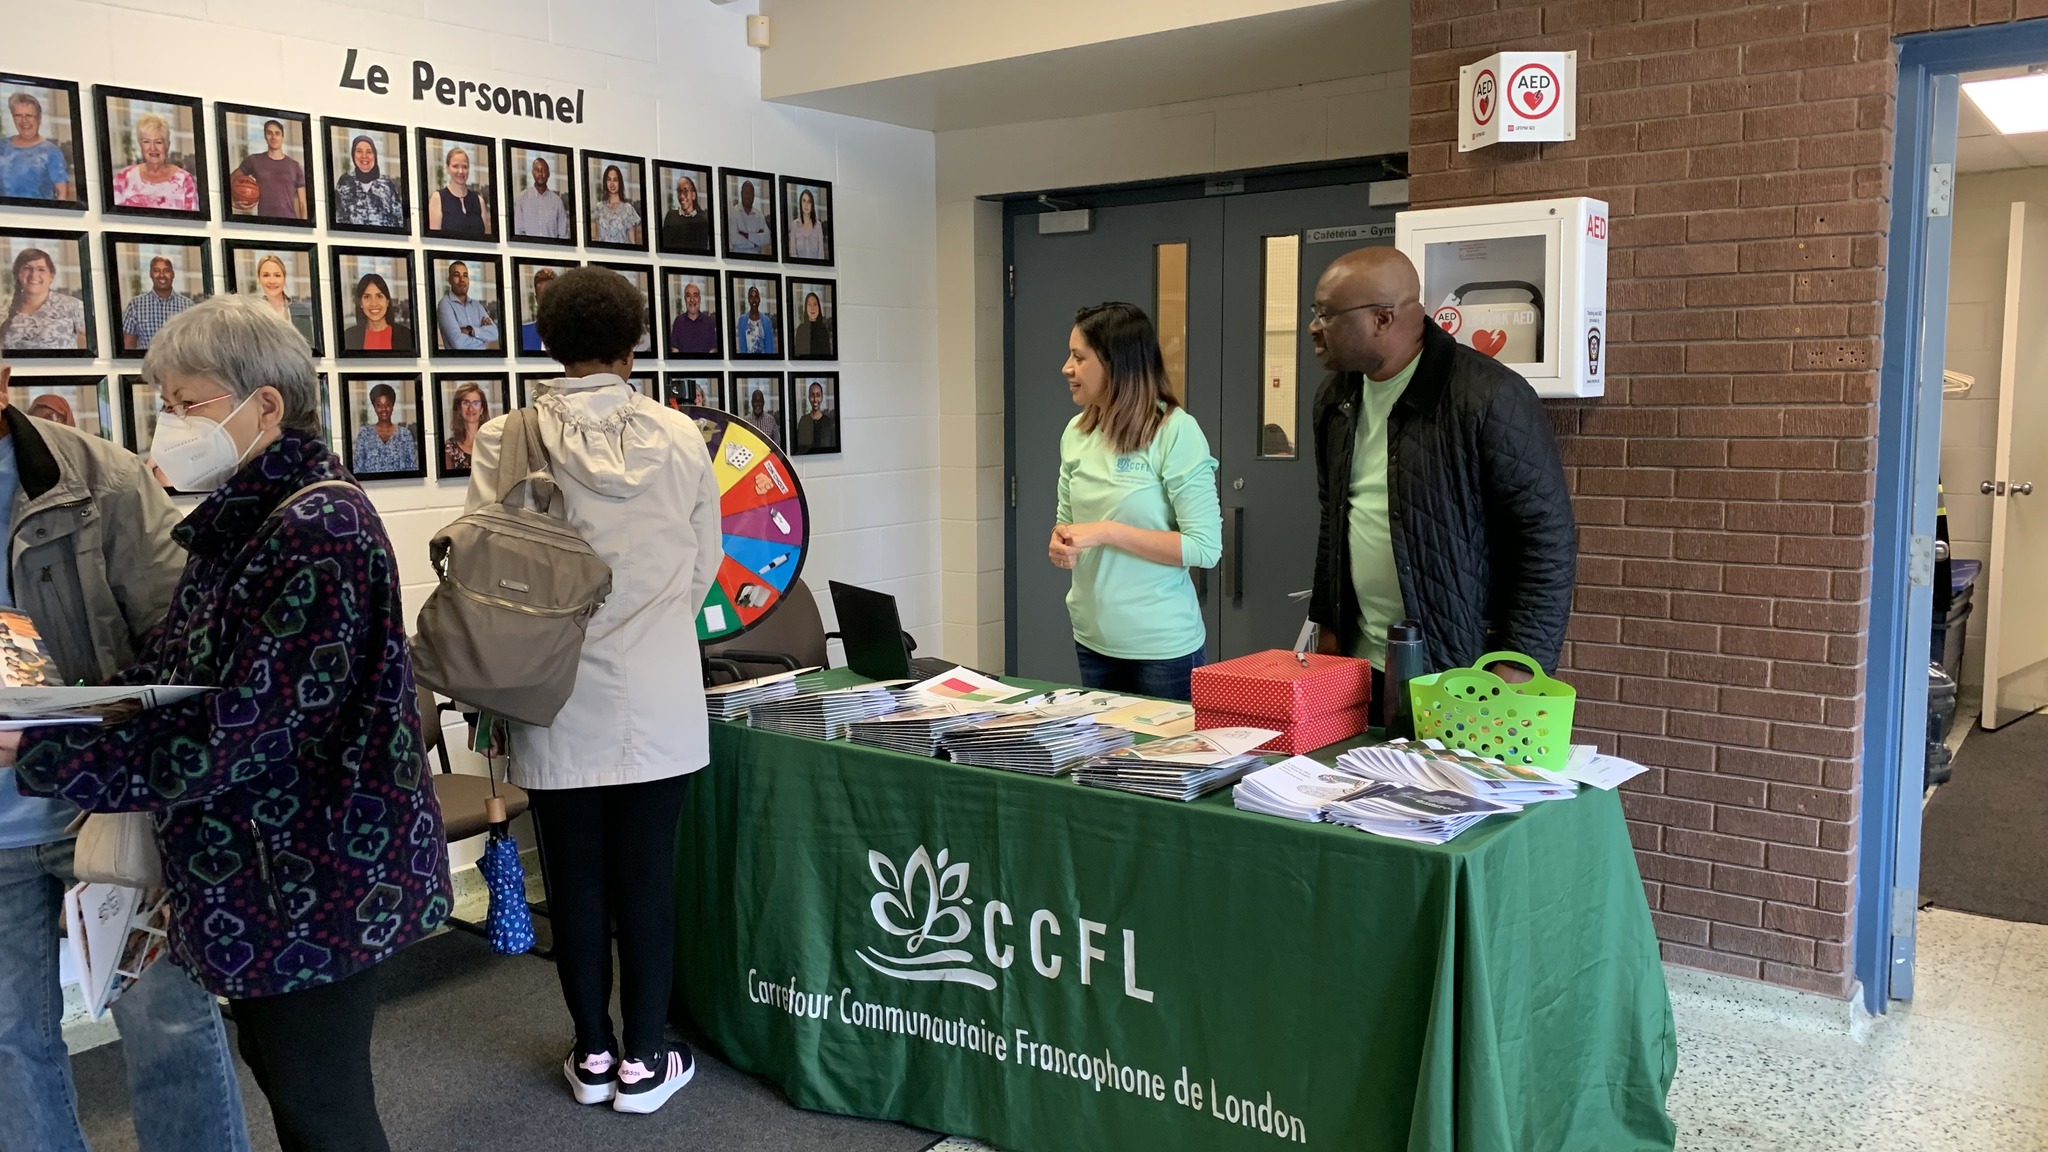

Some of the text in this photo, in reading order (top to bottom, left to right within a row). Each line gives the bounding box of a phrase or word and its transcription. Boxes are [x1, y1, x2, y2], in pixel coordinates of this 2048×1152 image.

[339, 48, 585, 124] Le Personnel
[1477, 79, 1493, 97] AED
[1517, 75, 1551, 89] AED
[1313, 227, 1357, 240] Cafétéria
[1586, 213, 1607, 240] AED
[1438, 312, 1457, 322] AED
[1512, 310, 1535, 325] AED
[983, 900, 1154, 1003] CCFL
[590, 1059, 610, 1067] adidas
[748, 968, 1307, 1144] Carrefour Communautaire Francophone de London
